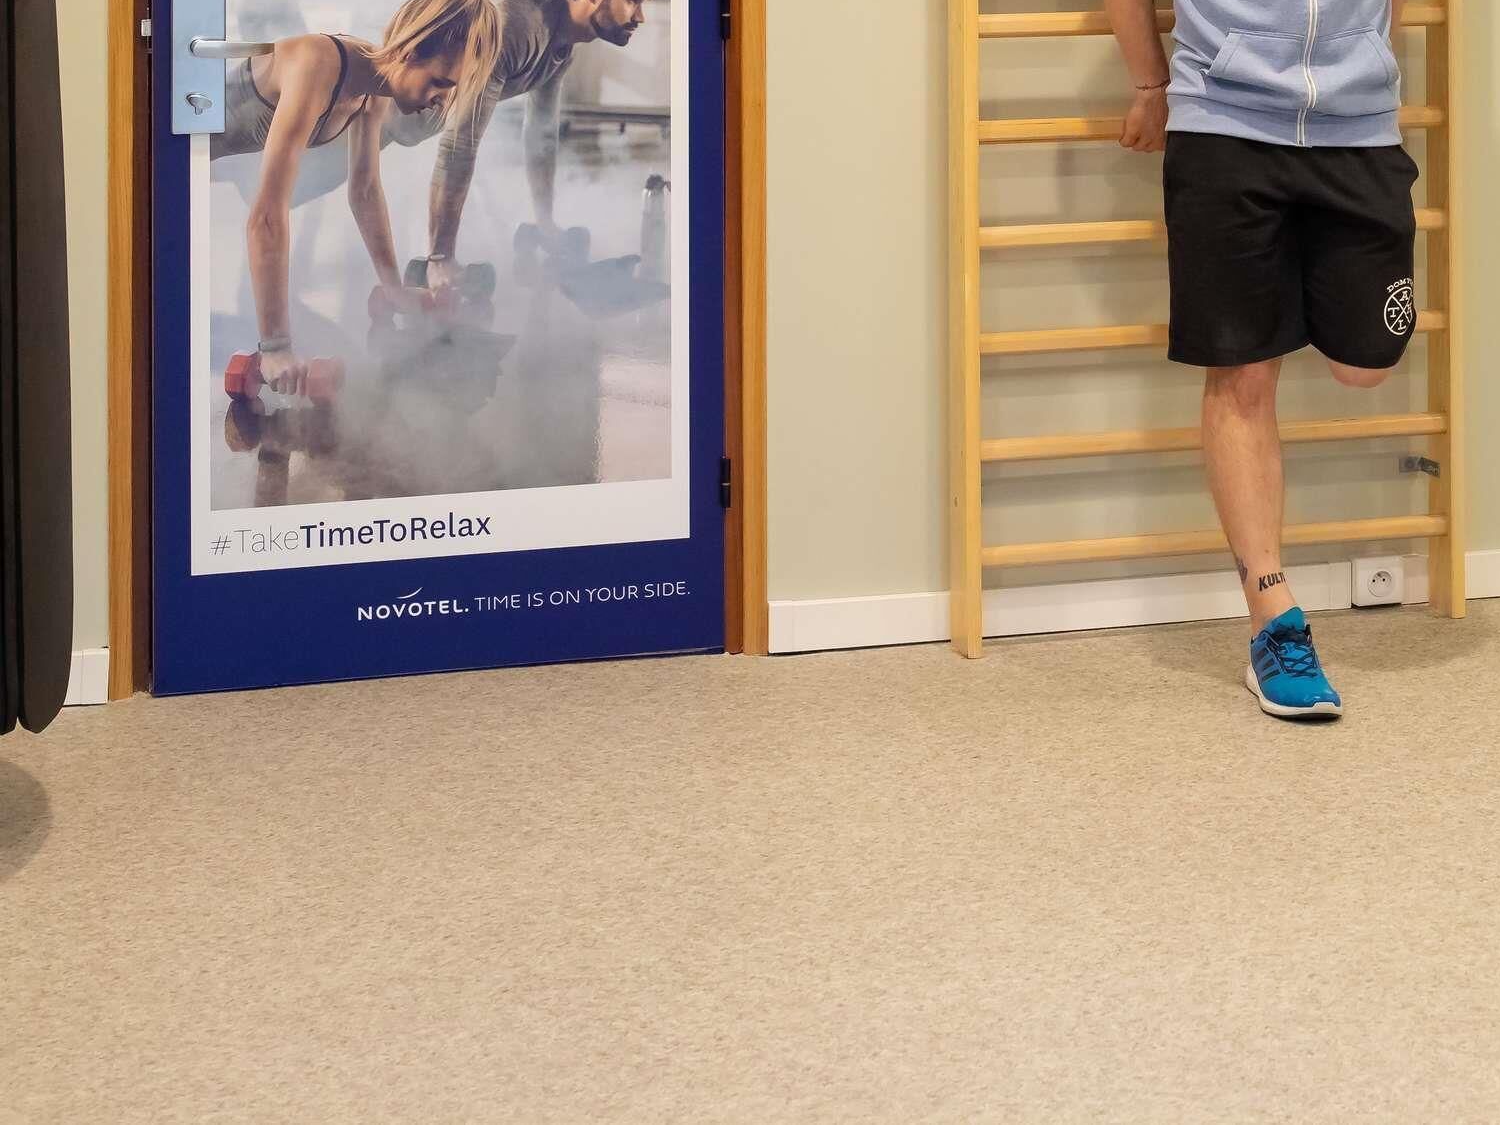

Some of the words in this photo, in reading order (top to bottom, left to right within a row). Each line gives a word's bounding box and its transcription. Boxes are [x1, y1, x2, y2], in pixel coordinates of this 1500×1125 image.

[208, 511, 492, 557] #TakeTimeToRelax
[474, 593, 521, 613] TIME
[527, 592, 545, 609] IS
[549, 589, 580, 606] ON
[585, 586, 639, 604] YOUR
[643, 580, 692, 599] SIDE.
